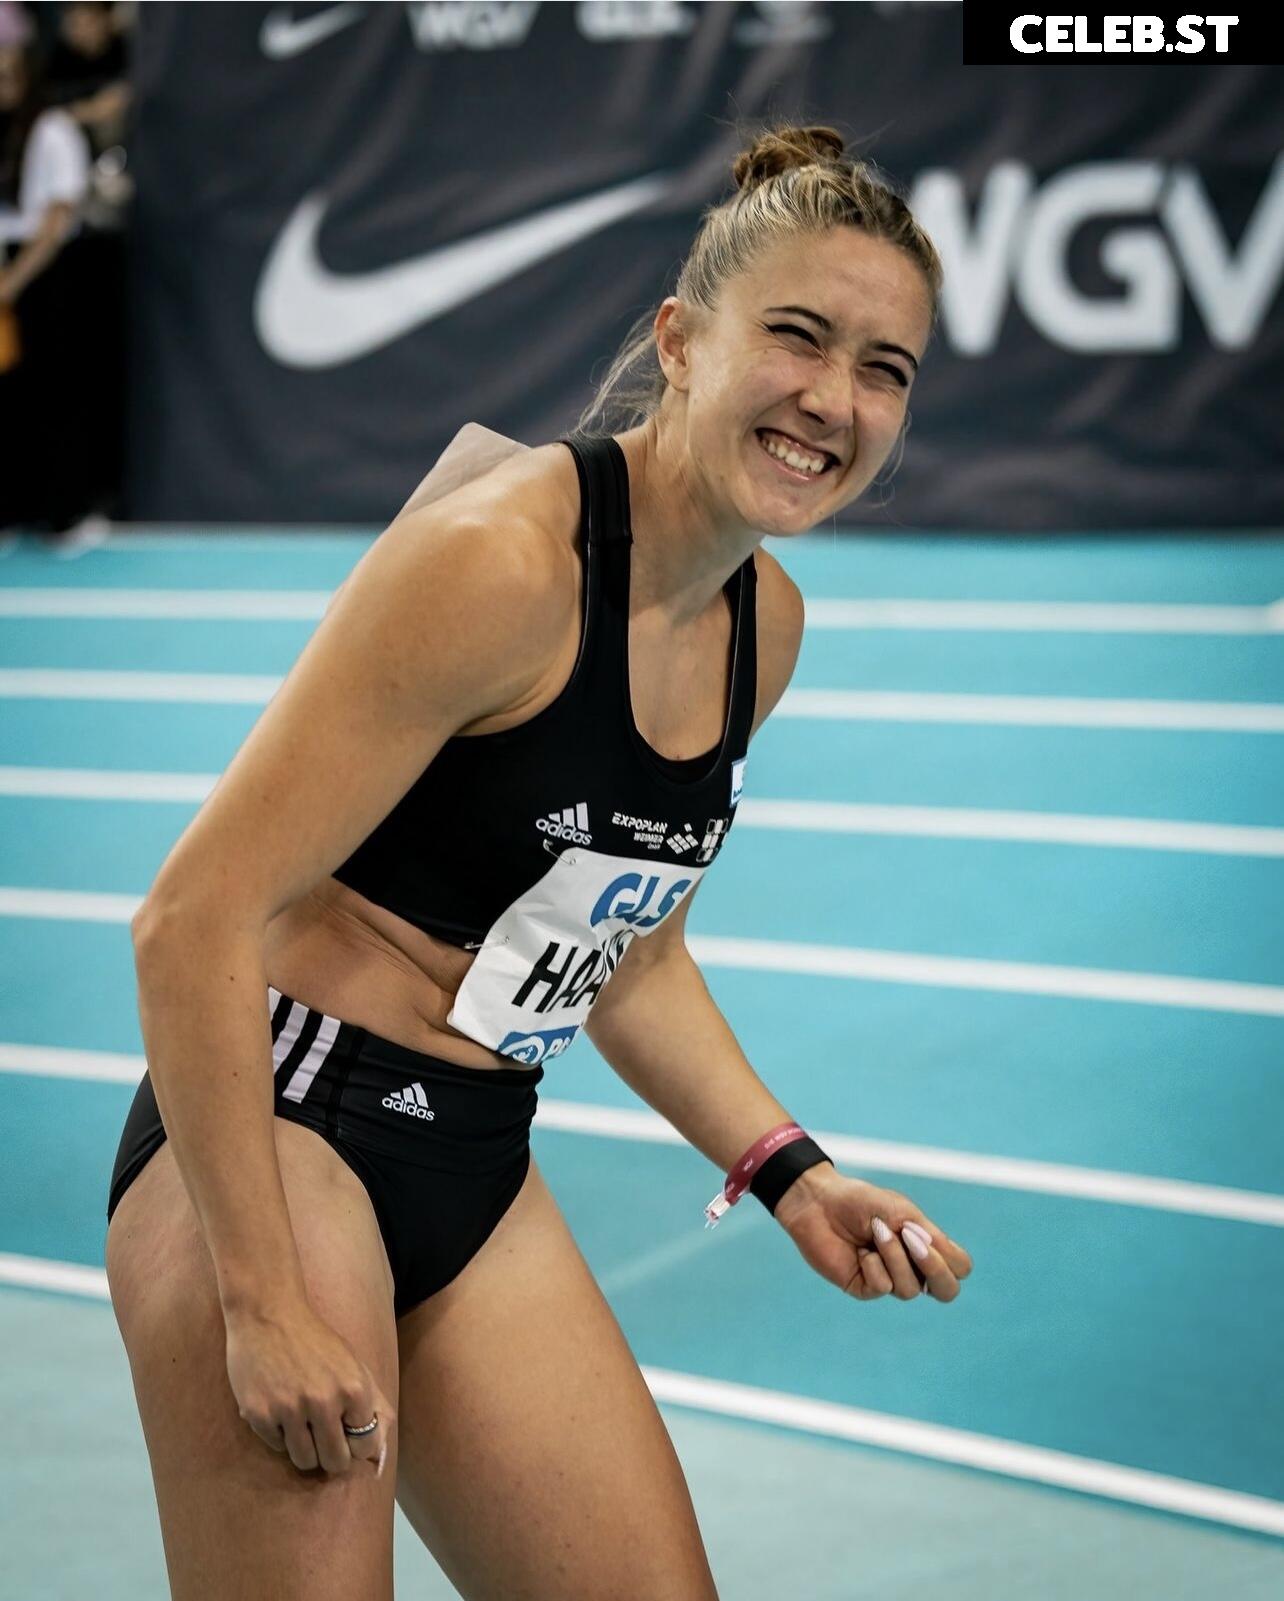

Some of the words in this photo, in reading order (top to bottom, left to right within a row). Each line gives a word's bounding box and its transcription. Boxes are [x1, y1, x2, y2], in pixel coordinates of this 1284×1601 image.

[535, 818, 593, 846] adidas
[611, 811, 668, 834] EXPOPLAN
[590, 872, 693, 928] GLS
[381, 1096, 435, 1121] adidas
